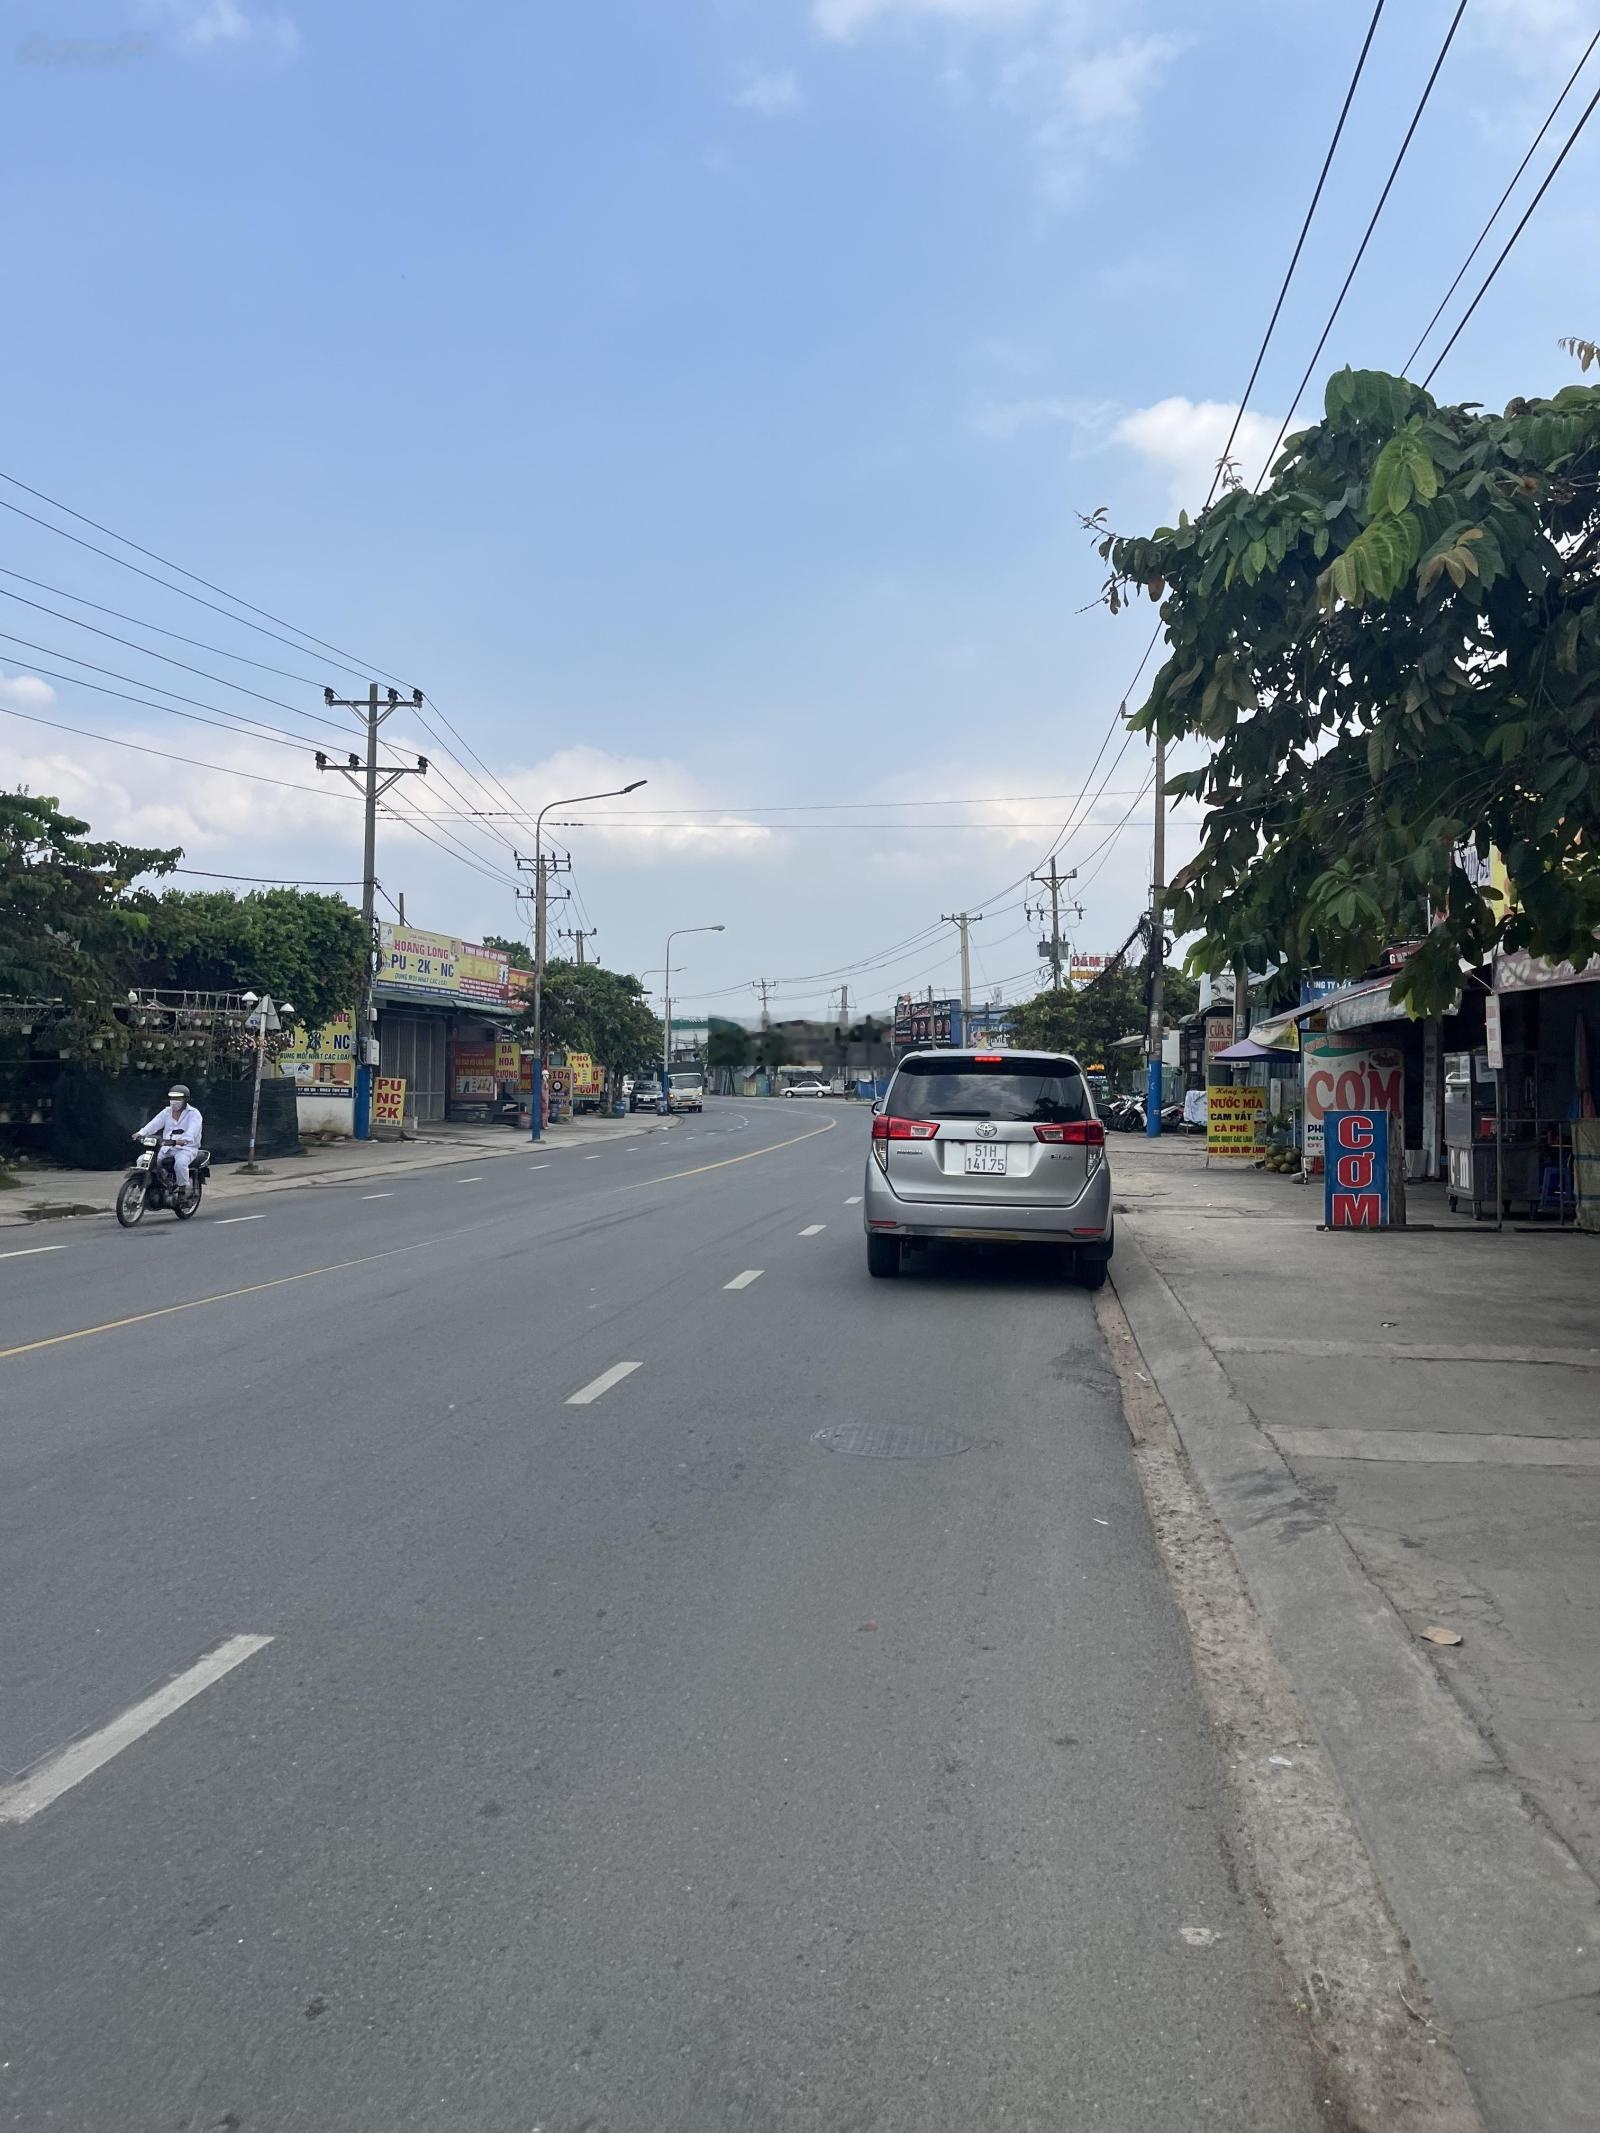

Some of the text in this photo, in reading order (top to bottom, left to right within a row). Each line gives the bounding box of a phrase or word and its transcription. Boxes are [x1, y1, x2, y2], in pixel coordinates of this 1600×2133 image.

[427, 946, 449, 960] LONG
[391, 953, 407, 970] PU
[417, 959, 431, 974] 2K
[441, 963, 454, 978] NC
[333, 1034, 350, 1049] NC
[377, 1079, 402, 1091] PU
[1306, 1061, 1402, 1120] CƠM
[376, 1092, 402, 1105] NC
[376, 1106, 399, 1118] 2K
[1307, 1124, 1324, 1133] PH
[975, 1144, 997, 1157] 51H
[967, 1158, 1004, 1171] 141.75
